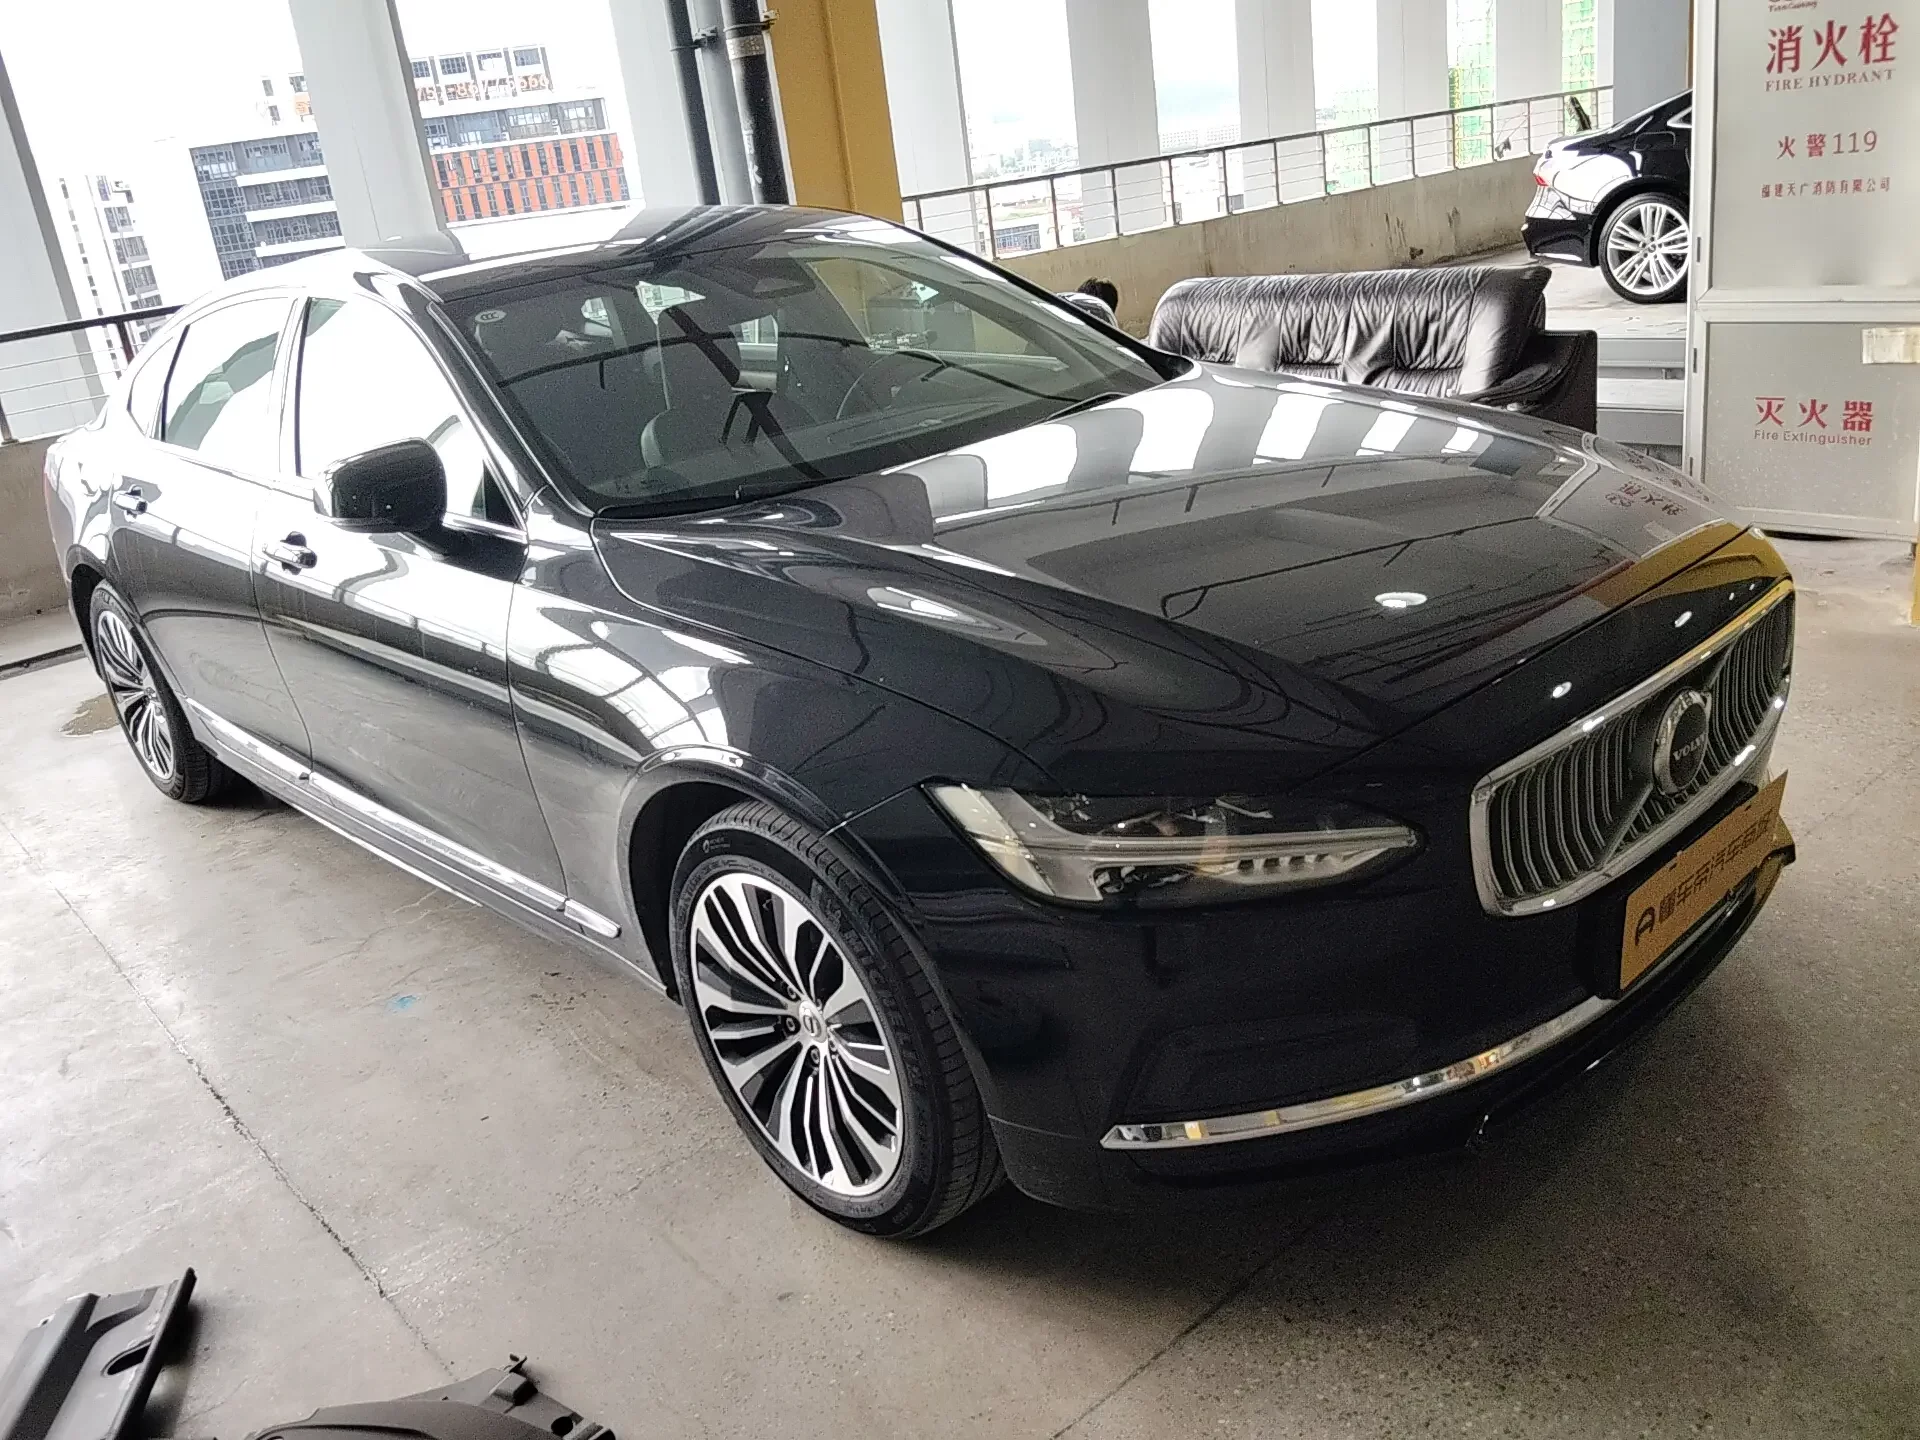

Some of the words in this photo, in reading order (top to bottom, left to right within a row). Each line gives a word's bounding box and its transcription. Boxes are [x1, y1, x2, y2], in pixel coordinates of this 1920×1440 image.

[1766, 13, 1899, 74] 消火栓
[1765, 77, 1803, 92] FIRE
[1809, 69, 1895, 88] HYDRANT
[1777, 131, 1878, 159] 火警119
[1755, 397, 1873, 432] 灭火器
[1754, 430, 1778, 441] Fire
[1783, 430, 1873, 446] Extinguisher
